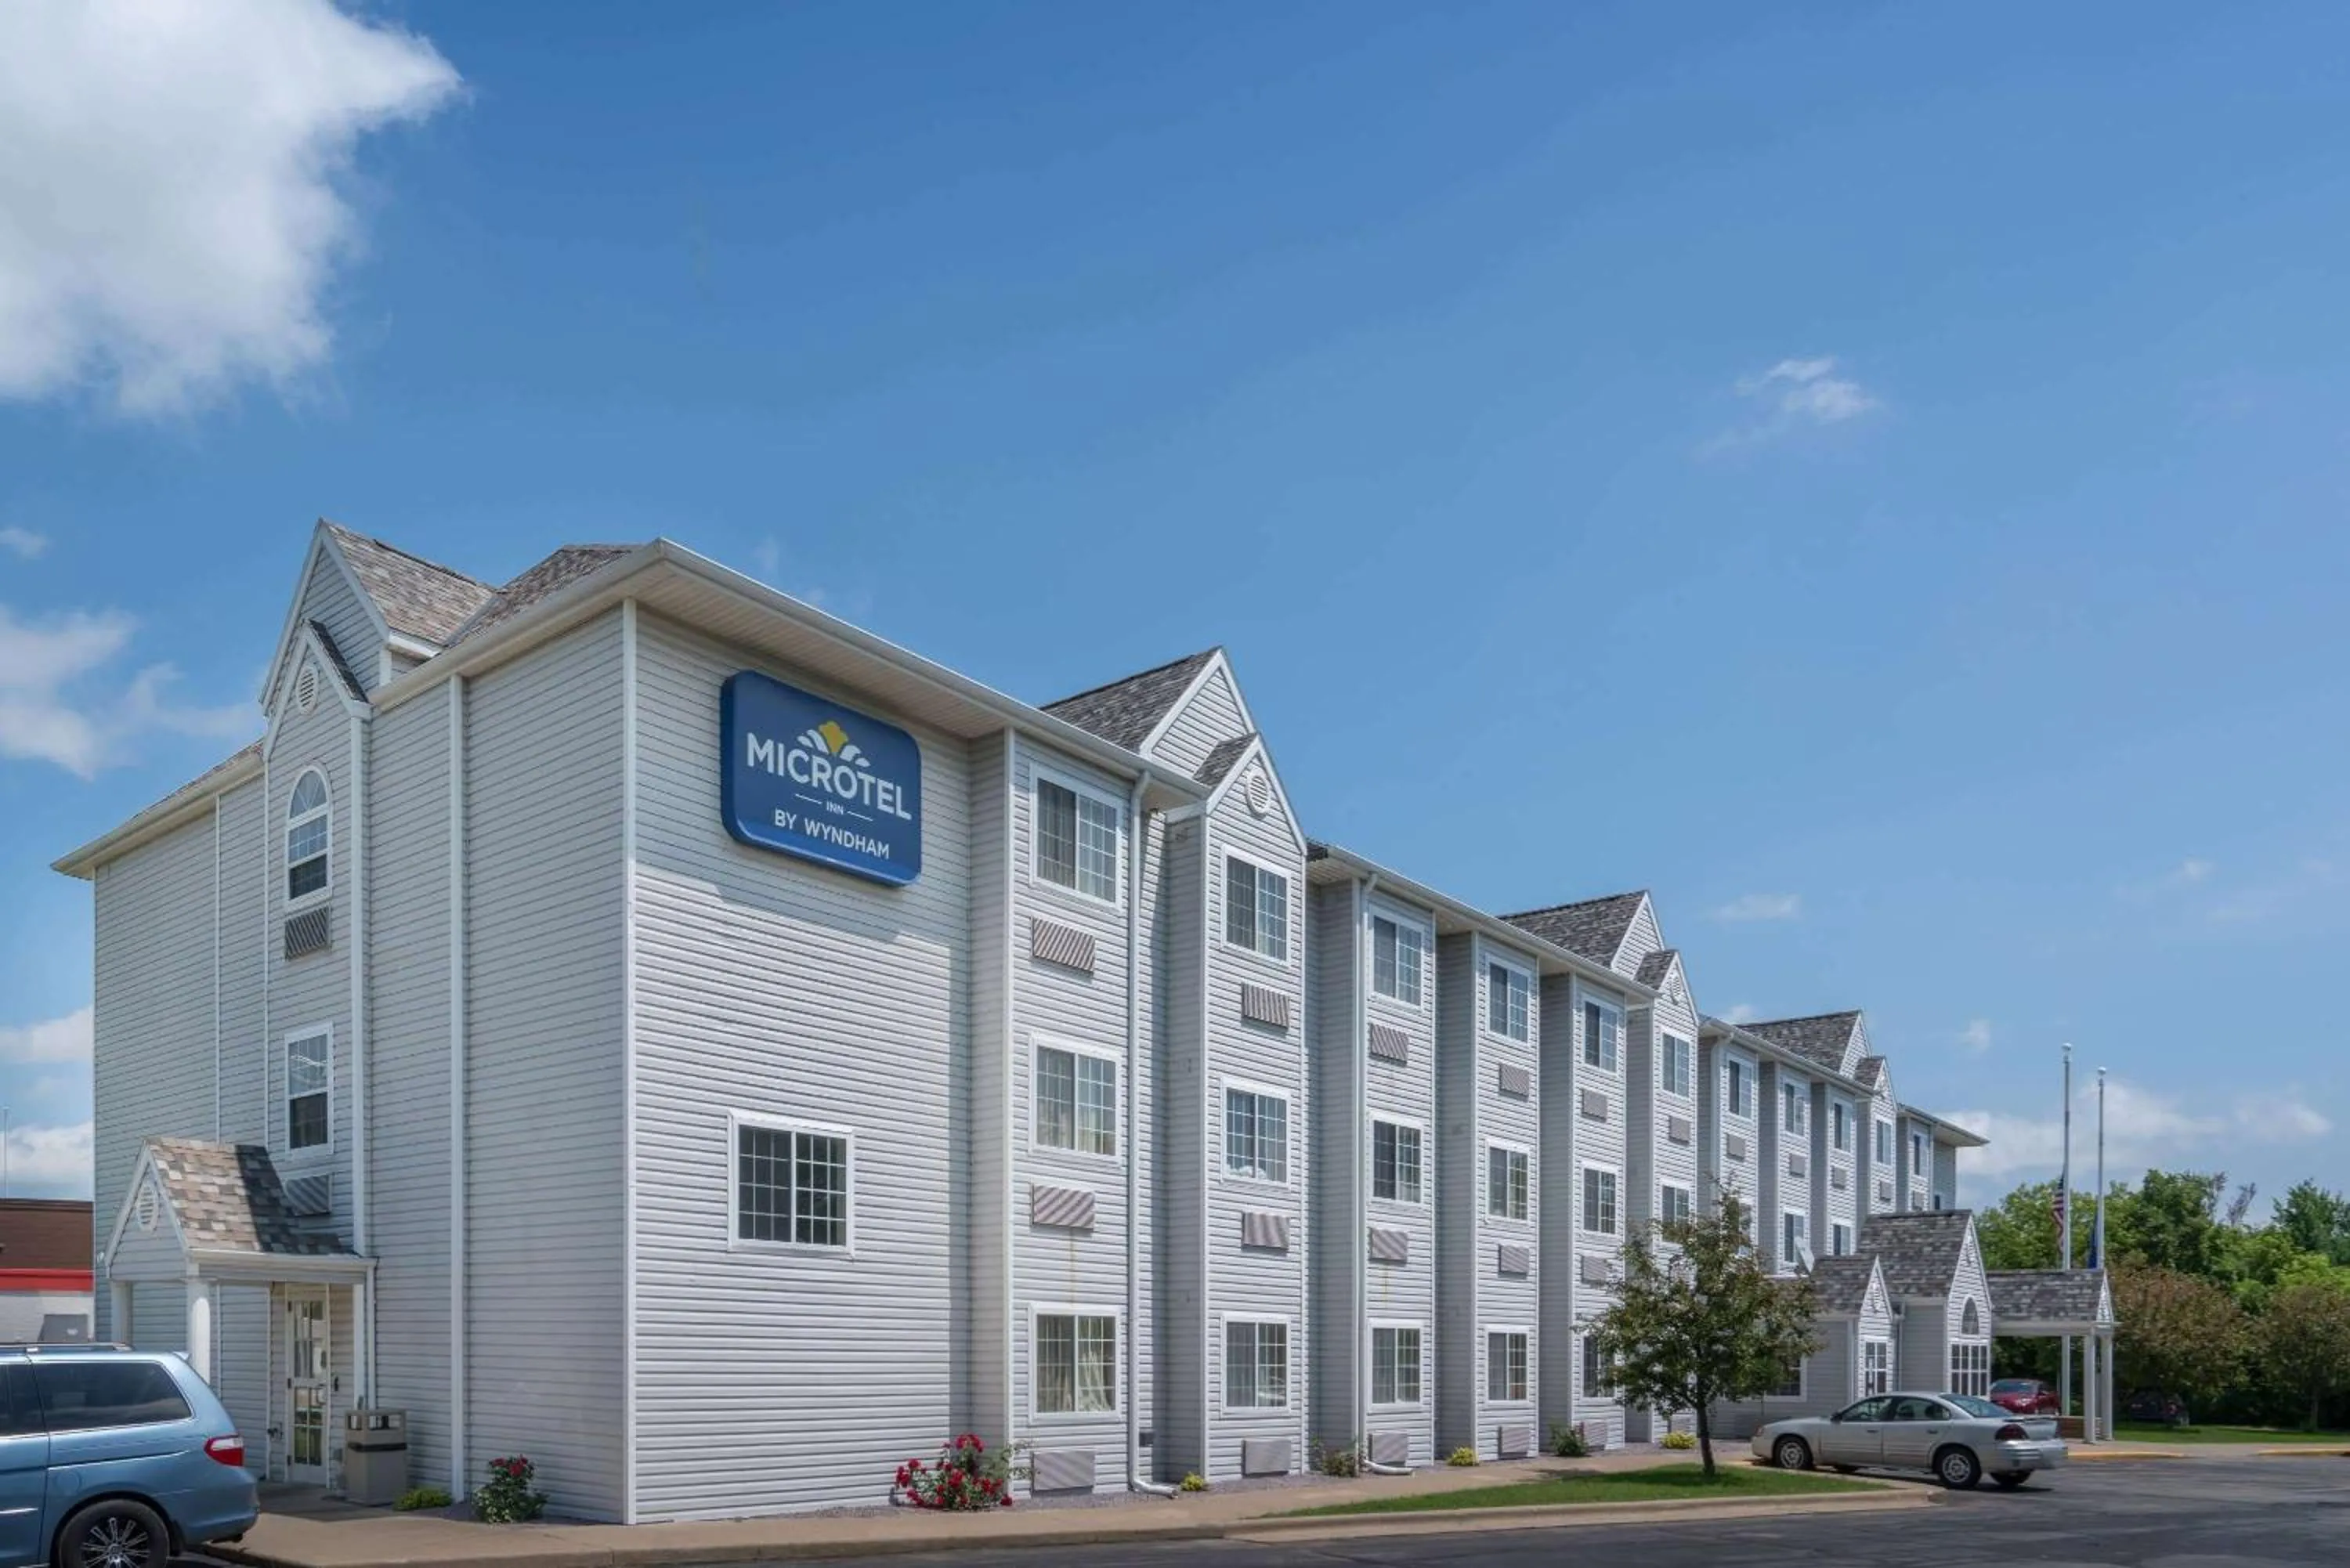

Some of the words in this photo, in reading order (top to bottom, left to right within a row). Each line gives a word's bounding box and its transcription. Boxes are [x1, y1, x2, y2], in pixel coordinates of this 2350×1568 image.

[747, 732, 912, 820] MICROTEL
[774, 808, 797, 829] BY
[804, 818, 890, 859] WYNDHAM
[826, 801, 844, 815] INN
